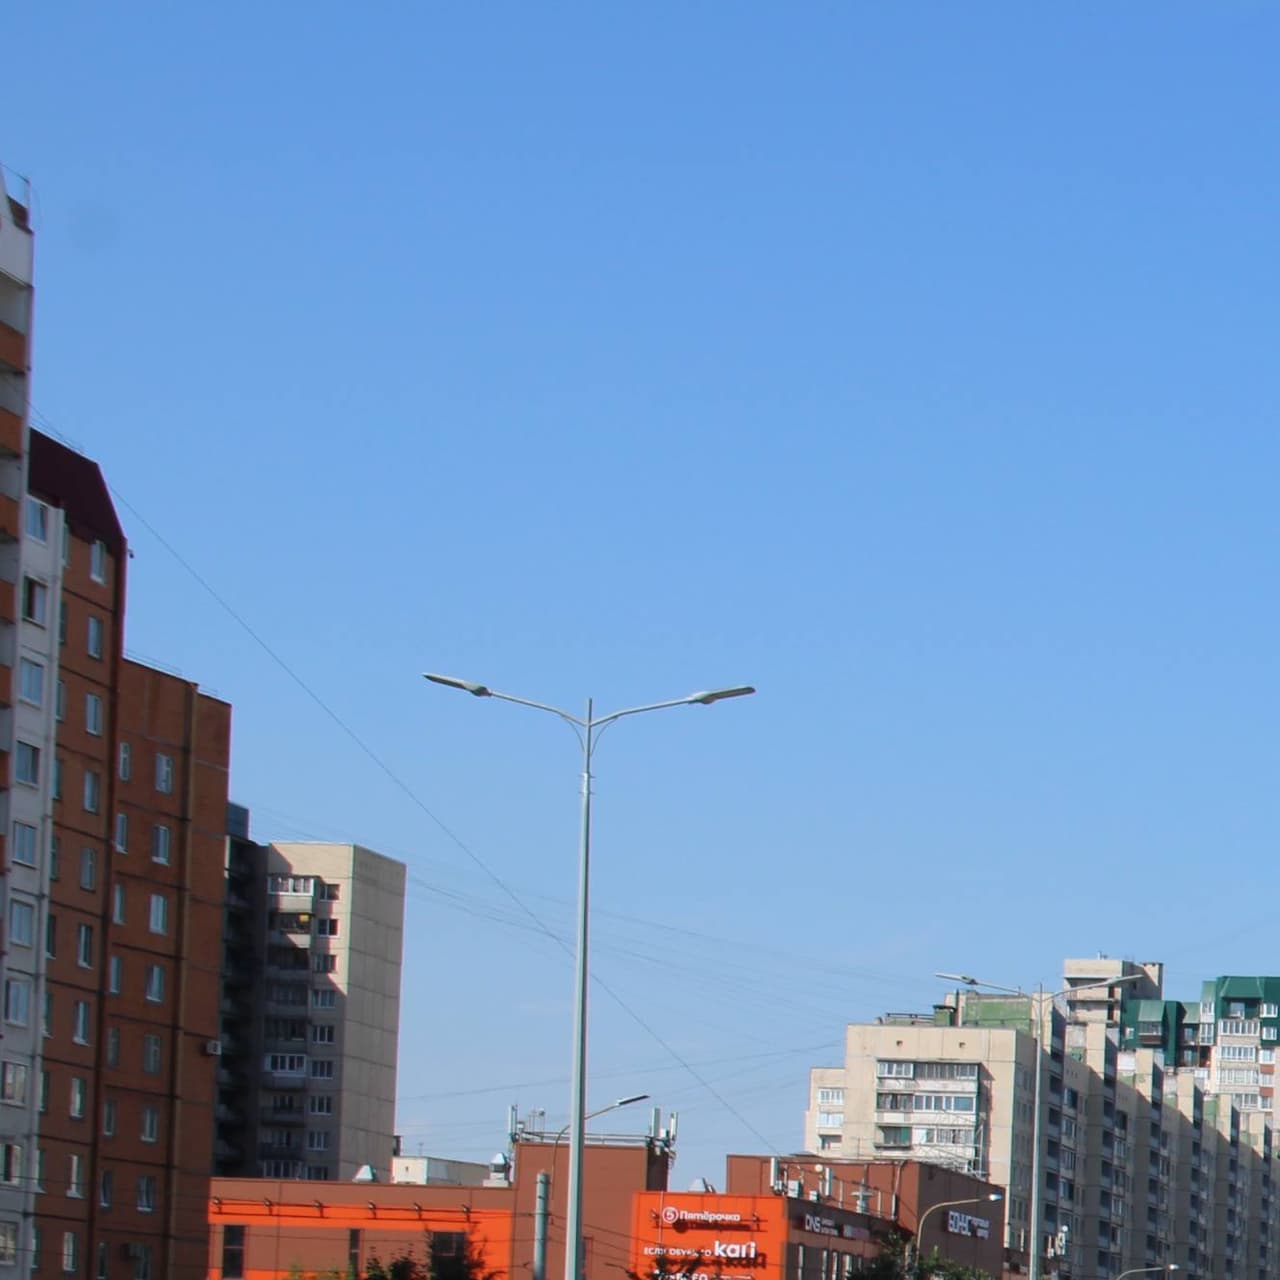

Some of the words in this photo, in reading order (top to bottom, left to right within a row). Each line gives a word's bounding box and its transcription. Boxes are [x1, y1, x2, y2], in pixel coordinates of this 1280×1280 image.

[679, 1211, 741, 1222] Пятёрочка
[804, 1213, 821, 1233] DNS
[714, 1240, 756, 1258] kari
